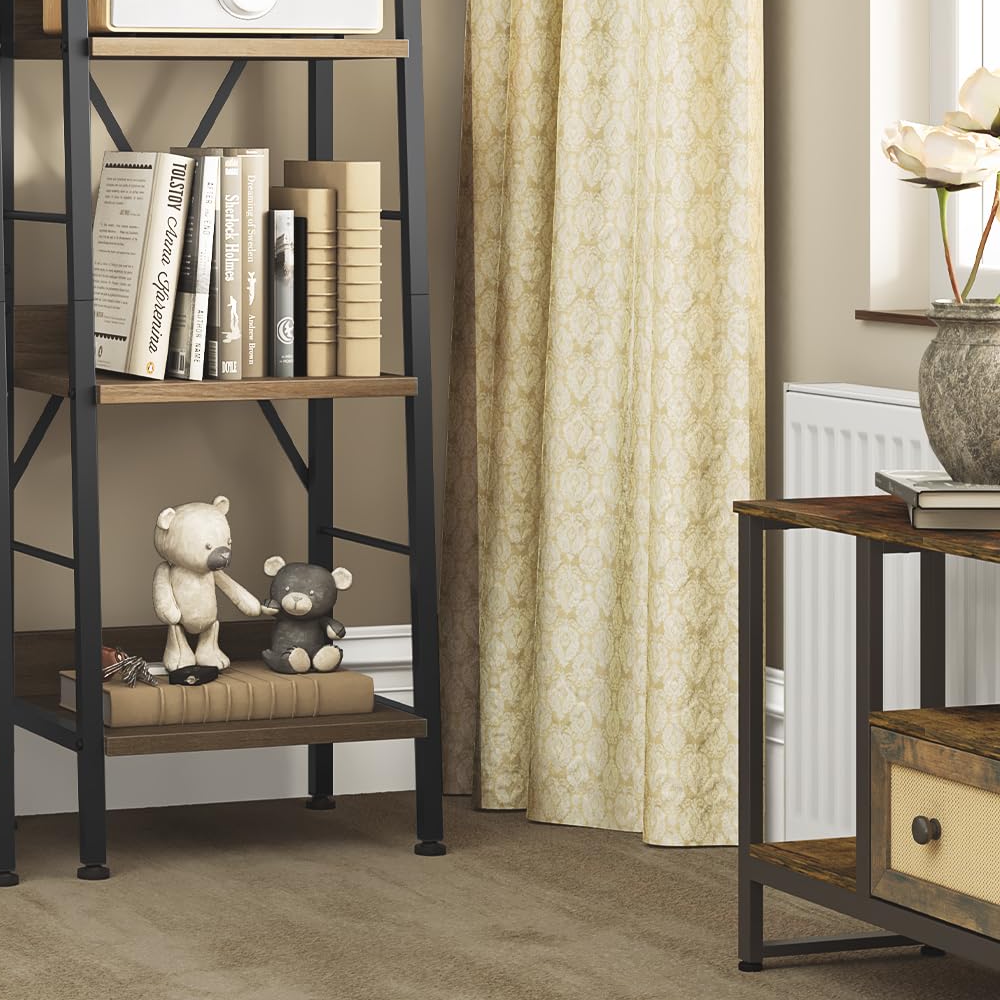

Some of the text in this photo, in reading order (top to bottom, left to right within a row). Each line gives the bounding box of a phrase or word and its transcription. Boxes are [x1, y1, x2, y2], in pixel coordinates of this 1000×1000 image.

[224, 194, 240, 241] Sherlock
[148, 162, 187, 354] TOLSTOY Anna Karenina
[224, 243, 240, 282] Holmes
[245, 175, 256, 365] Dreaming of Sweden Andrew Brown
[193, 309, 204, 364] AUTHOR NAME
